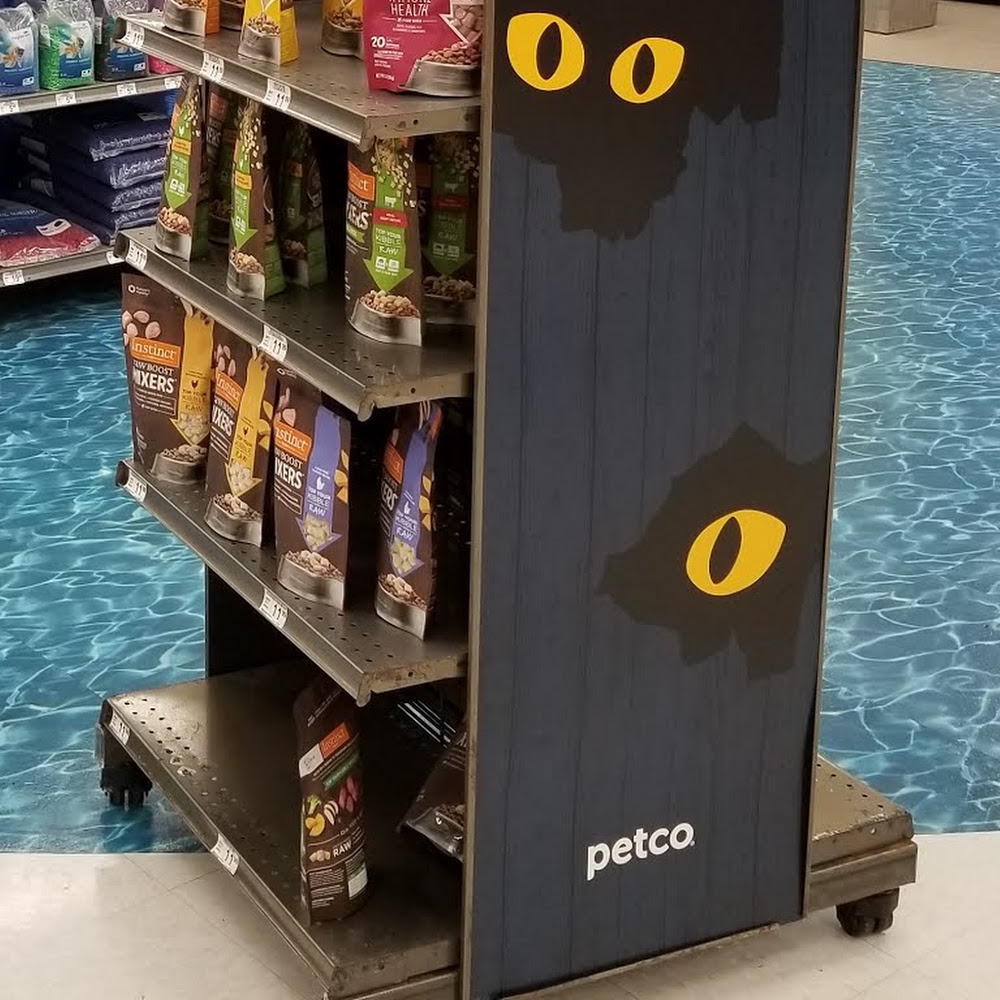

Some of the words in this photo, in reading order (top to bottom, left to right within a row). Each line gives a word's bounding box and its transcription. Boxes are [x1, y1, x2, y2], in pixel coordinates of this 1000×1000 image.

[391, 3, 429, 17] HEALTH
[371, 36, 385, 48] 20
[375, 235, 401, 245] KIBBLE
[386, 230, 401, 238] YOUR
[380, 246, 398, 255] RAW
[309, 504, 326, 516] RAW
[333, 840, 352, 858] RAW
[587, 822, 695, 881] petco
